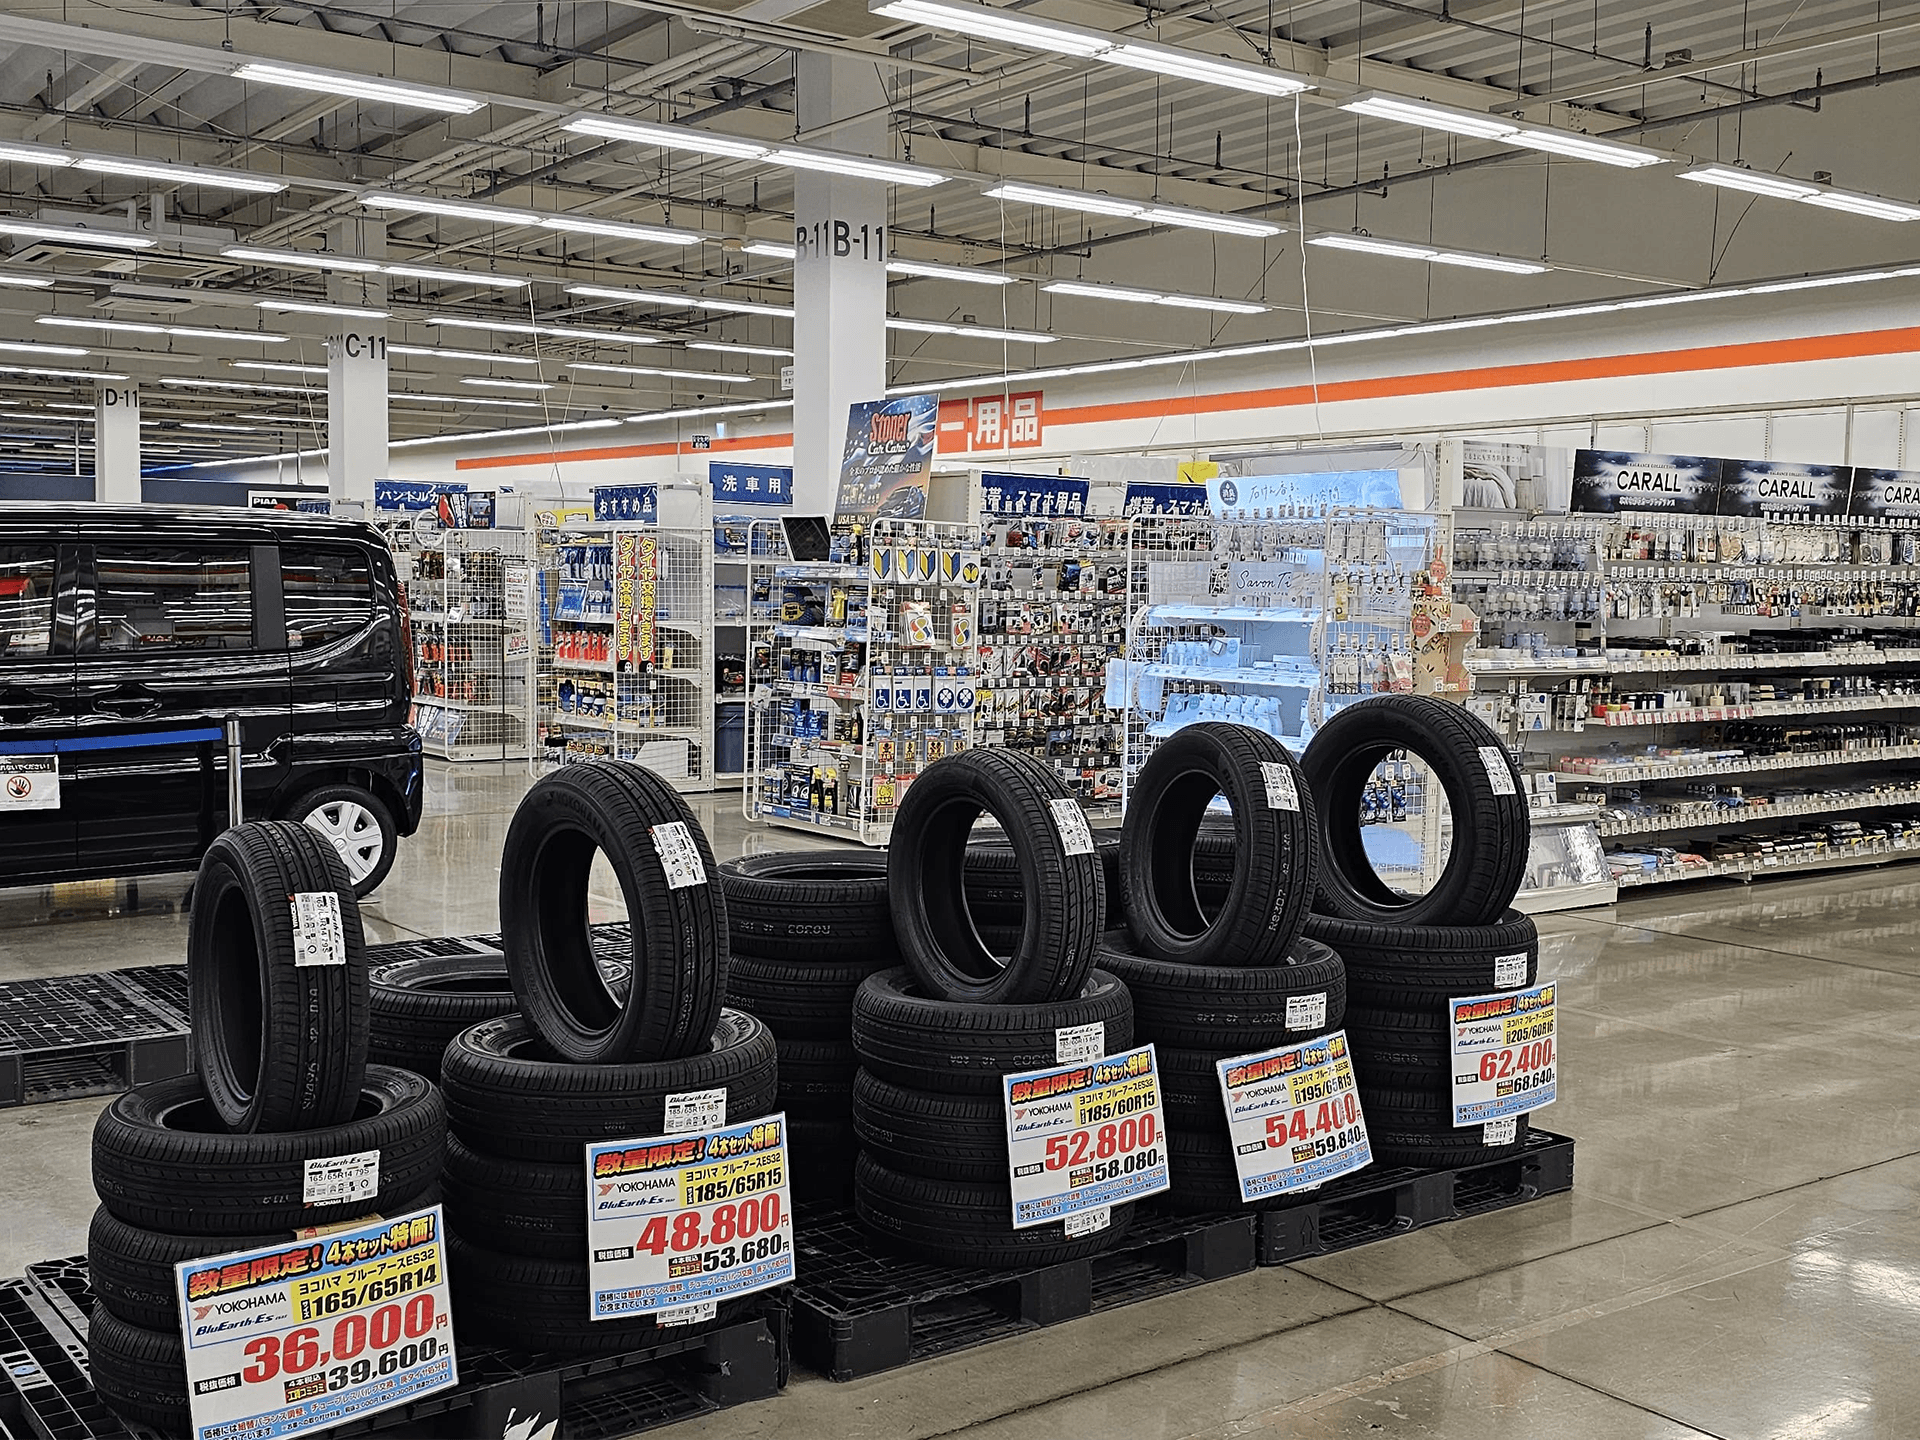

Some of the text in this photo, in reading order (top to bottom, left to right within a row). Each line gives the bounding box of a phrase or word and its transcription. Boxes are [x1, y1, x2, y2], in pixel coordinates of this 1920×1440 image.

[834, 221, 883, 261] B-11
[346, 333, 385, 359] C-11
[105, 388, 138, 408] D-11
[869, 413, 910, 442] Stoner
[722, 475, 793, 494] 洗車用
[1617, 471, 1681, 492] CARALL
[1758, 479, 1816, 498] CARALL
[253, 497, 278, 506] PIAA
[599, 496, 652, 514] おすすめ品
[1236, 570, 1292, 589] Savon Ti
[619, 536, 634, 660] タイヤ交換できます
[640, 538, 656, 661] タイヤ交換できます
[1468, 1024, 1502, 1035] YOKOHAMA
[1511, 1020, 1554, 1043] 205/60R16
[1011, 1066, 1094, 1103] 数量限定!
[1080, 1077, 1154, 1105] ヨコハマ ブルーアースES32
[1245, 1083, 1287, 1099] YOKOHAMA
[1292, 1073, 1313, 1086] ヨコハマ
[1301, 1072, 1351, 1101] 195/65R15
[1028, 1101, 1073, 1117] YOKOHAMA
[1087, 1090, 1155, 1121] 185/60R15
[594, 1121, 780, 1178] 数量限定! 4本セット特価!
[309, 1171, 353, 1182] 165/65R14
[686, 1152, 780, 1183] ヨコハマ ブルーアースES32
[616, 1177, 675, 1193] YOKOHAMA
[694, 1169, 781, 1203] 185/65R15
[189, 1215, 435, 1300] 数量限定! 4本セット特価!
[299, 1249, 436, 1295] ヨコハマ ブルーアースES32
[312, 1264, 437, 1317] 165/65R14
[214, 1292, 287, 1315] YOKOHAMA
[199, 1376, 236, 1392] 税抜価格
[288, 1374, 323, 1387] 4本税込
